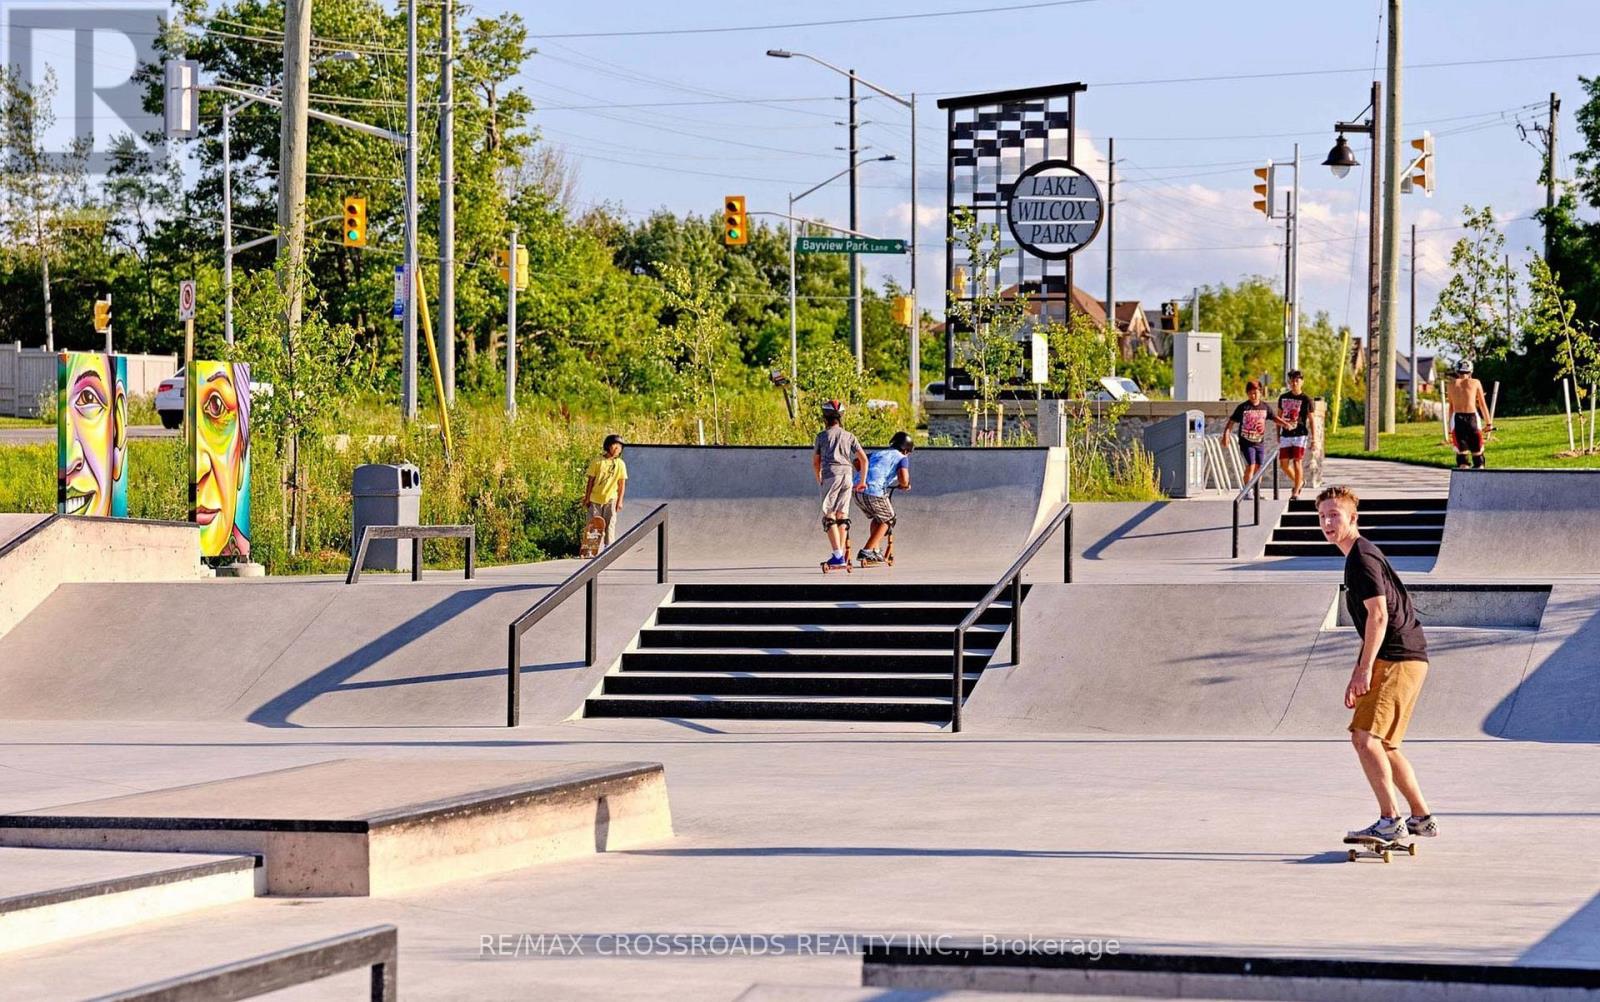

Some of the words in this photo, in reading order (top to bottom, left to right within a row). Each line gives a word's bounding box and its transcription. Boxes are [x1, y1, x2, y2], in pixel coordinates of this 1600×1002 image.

[1031, 176, 1079, 196] LAKE
[1018, 201, 1087, 221] WILCOX
[1030, 224, 1079, 244] PARK
[802, 240, 843, 252] Bayview
[846, 241, 869, 251] Park
